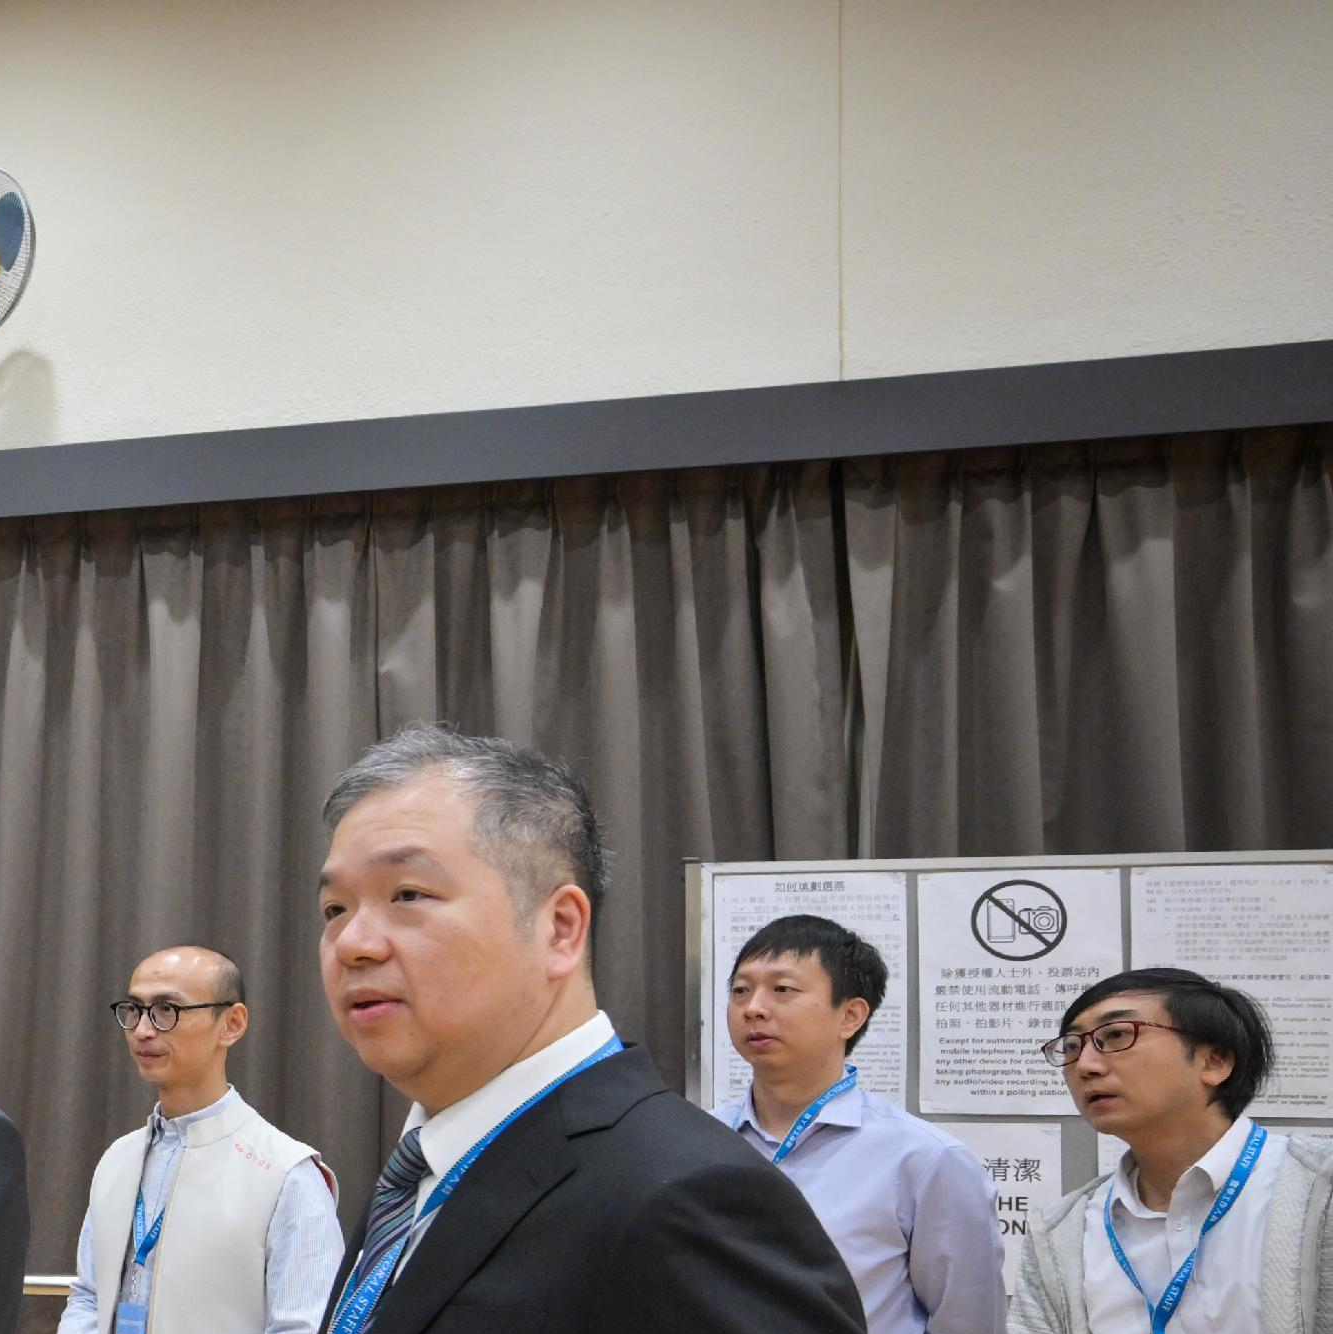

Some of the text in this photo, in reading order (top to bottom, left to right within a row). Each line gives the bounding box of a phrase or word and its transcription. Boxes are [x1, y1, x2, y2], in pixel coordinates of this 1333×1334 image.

[939, 1037, 969, 1045] Except
[971, 1037, 984, 1045] for
[986, 1037, 1032, 1045] authorized
[940, 1047, 970, 1055] mobile
[935, 1058, 950, 1066] any
[953, 1057, 977, 1065] other
[979, 1057, 1007, 1065] device
[1010, 1057, 1022, 1065] for
[936, 1067, 963, 1076] taking
[934, 1078, 950, 1086] any
[953, 1077, 1004, 1086] audio/video
[1006, 1077, 1048, 1086] recording
[970, 1088, 997, 1096] within
[1006, 1088, 1036, 1097] polling
[1240, 1147, 1256, 1169] STAFF
[982, 1157, 1042, 1182] 清潔
[998, 1196, 1029, 1211] HE
[999, 1218, 1026, 1235] ON
[1162, 1285, 1180, 1311] STAFF
